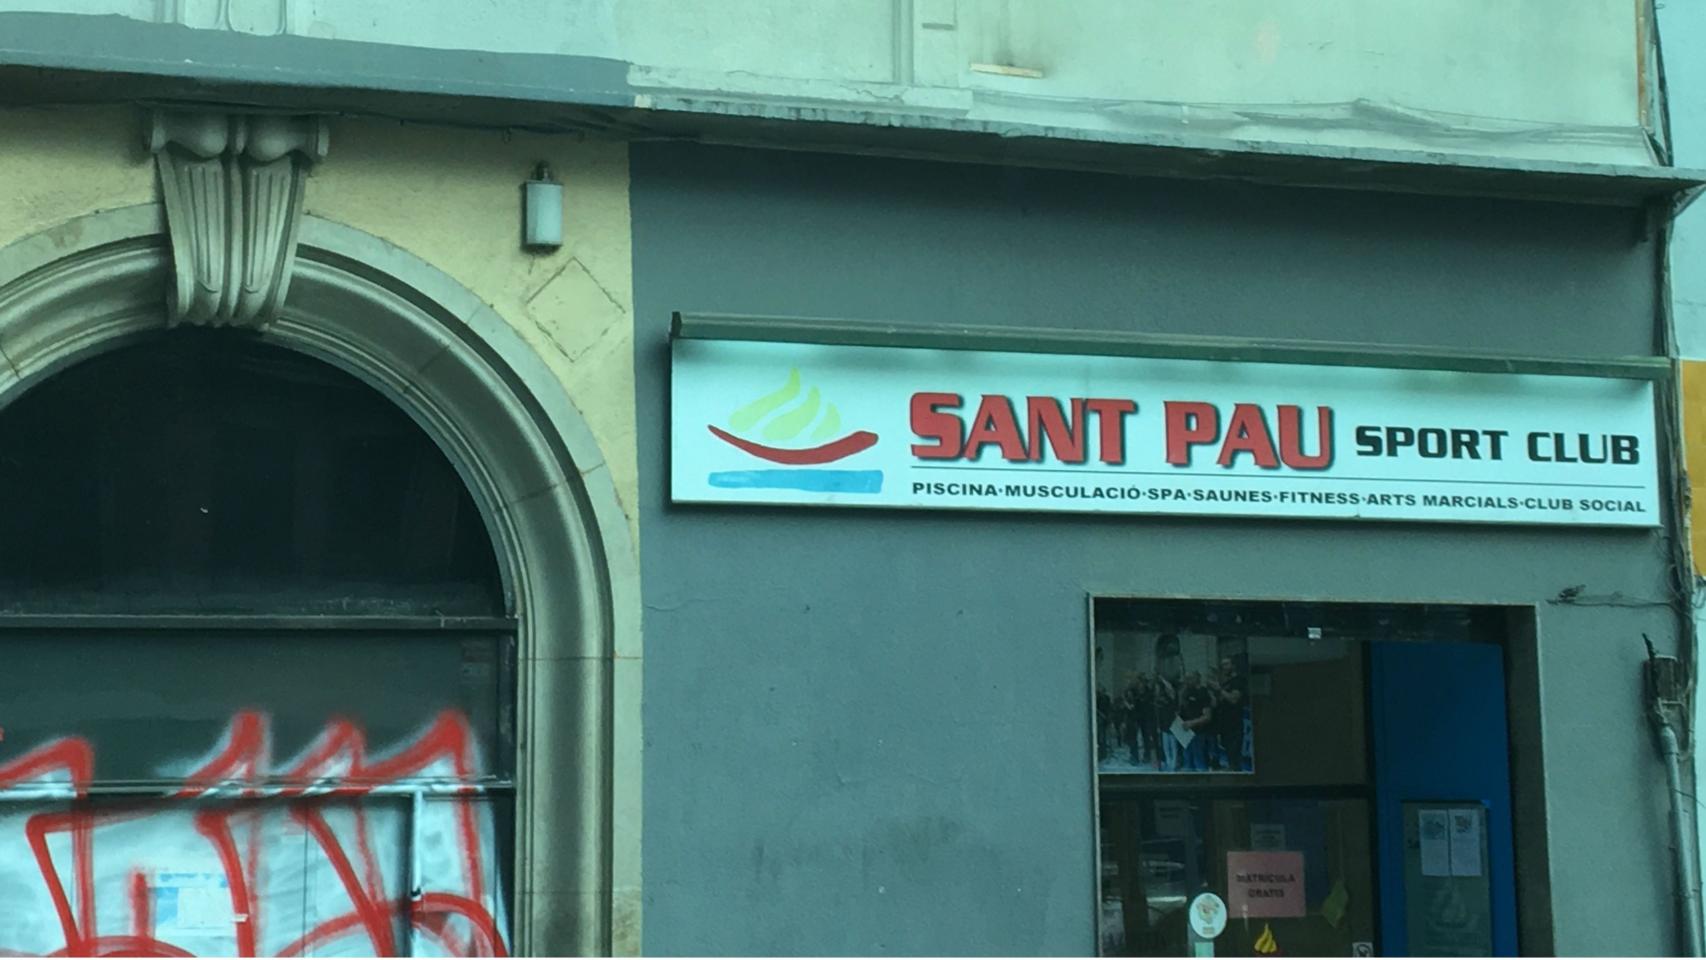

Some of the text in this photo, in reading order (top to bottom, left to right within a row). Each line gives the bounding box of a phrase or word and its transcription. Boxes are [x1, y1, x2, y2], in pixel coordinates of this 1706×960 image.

[909, 391, 1640, 472] SANT PAU SPORT CLUB
[911, 481, 998, 497] PISCINA
[1147, 487, 1187, 501] SPA
[1192, 489, 1273, 503] SAUNES
[1278, 490, 1360, 505] FITNESS
[1366, 493, 1417, 507] ARTS
[1422, 494, 1519, 510] MARCIALS
[1523, 497, 1574, 512] CLUB
[1579, 498, 1647, 514] SOCIAL
